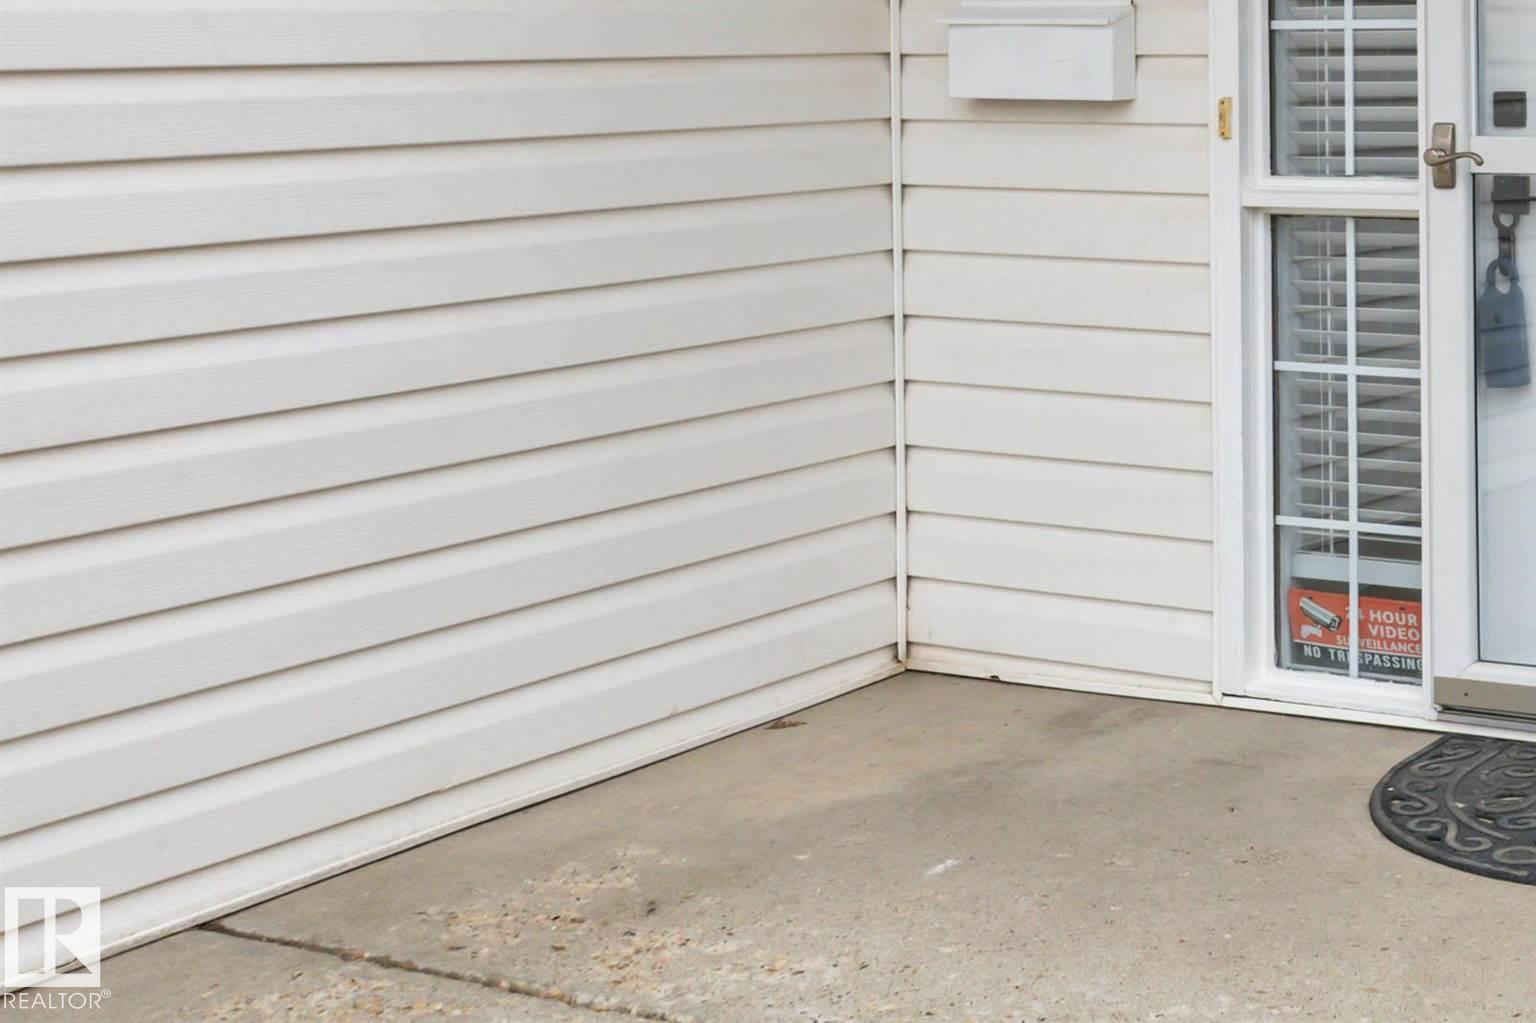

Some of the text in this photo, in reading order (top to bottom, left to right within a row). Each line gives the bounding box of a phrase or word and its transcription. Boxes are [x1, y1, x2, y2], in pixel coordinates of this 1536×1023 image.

[1369, 609, 1418, 626] HOUR
[1368, 624, 1420, 641] VIDEO
[1336, 634, 1422, 654] SUVEILLANCE
[1304, 645, 1423, 671] NO TRSPASSING
